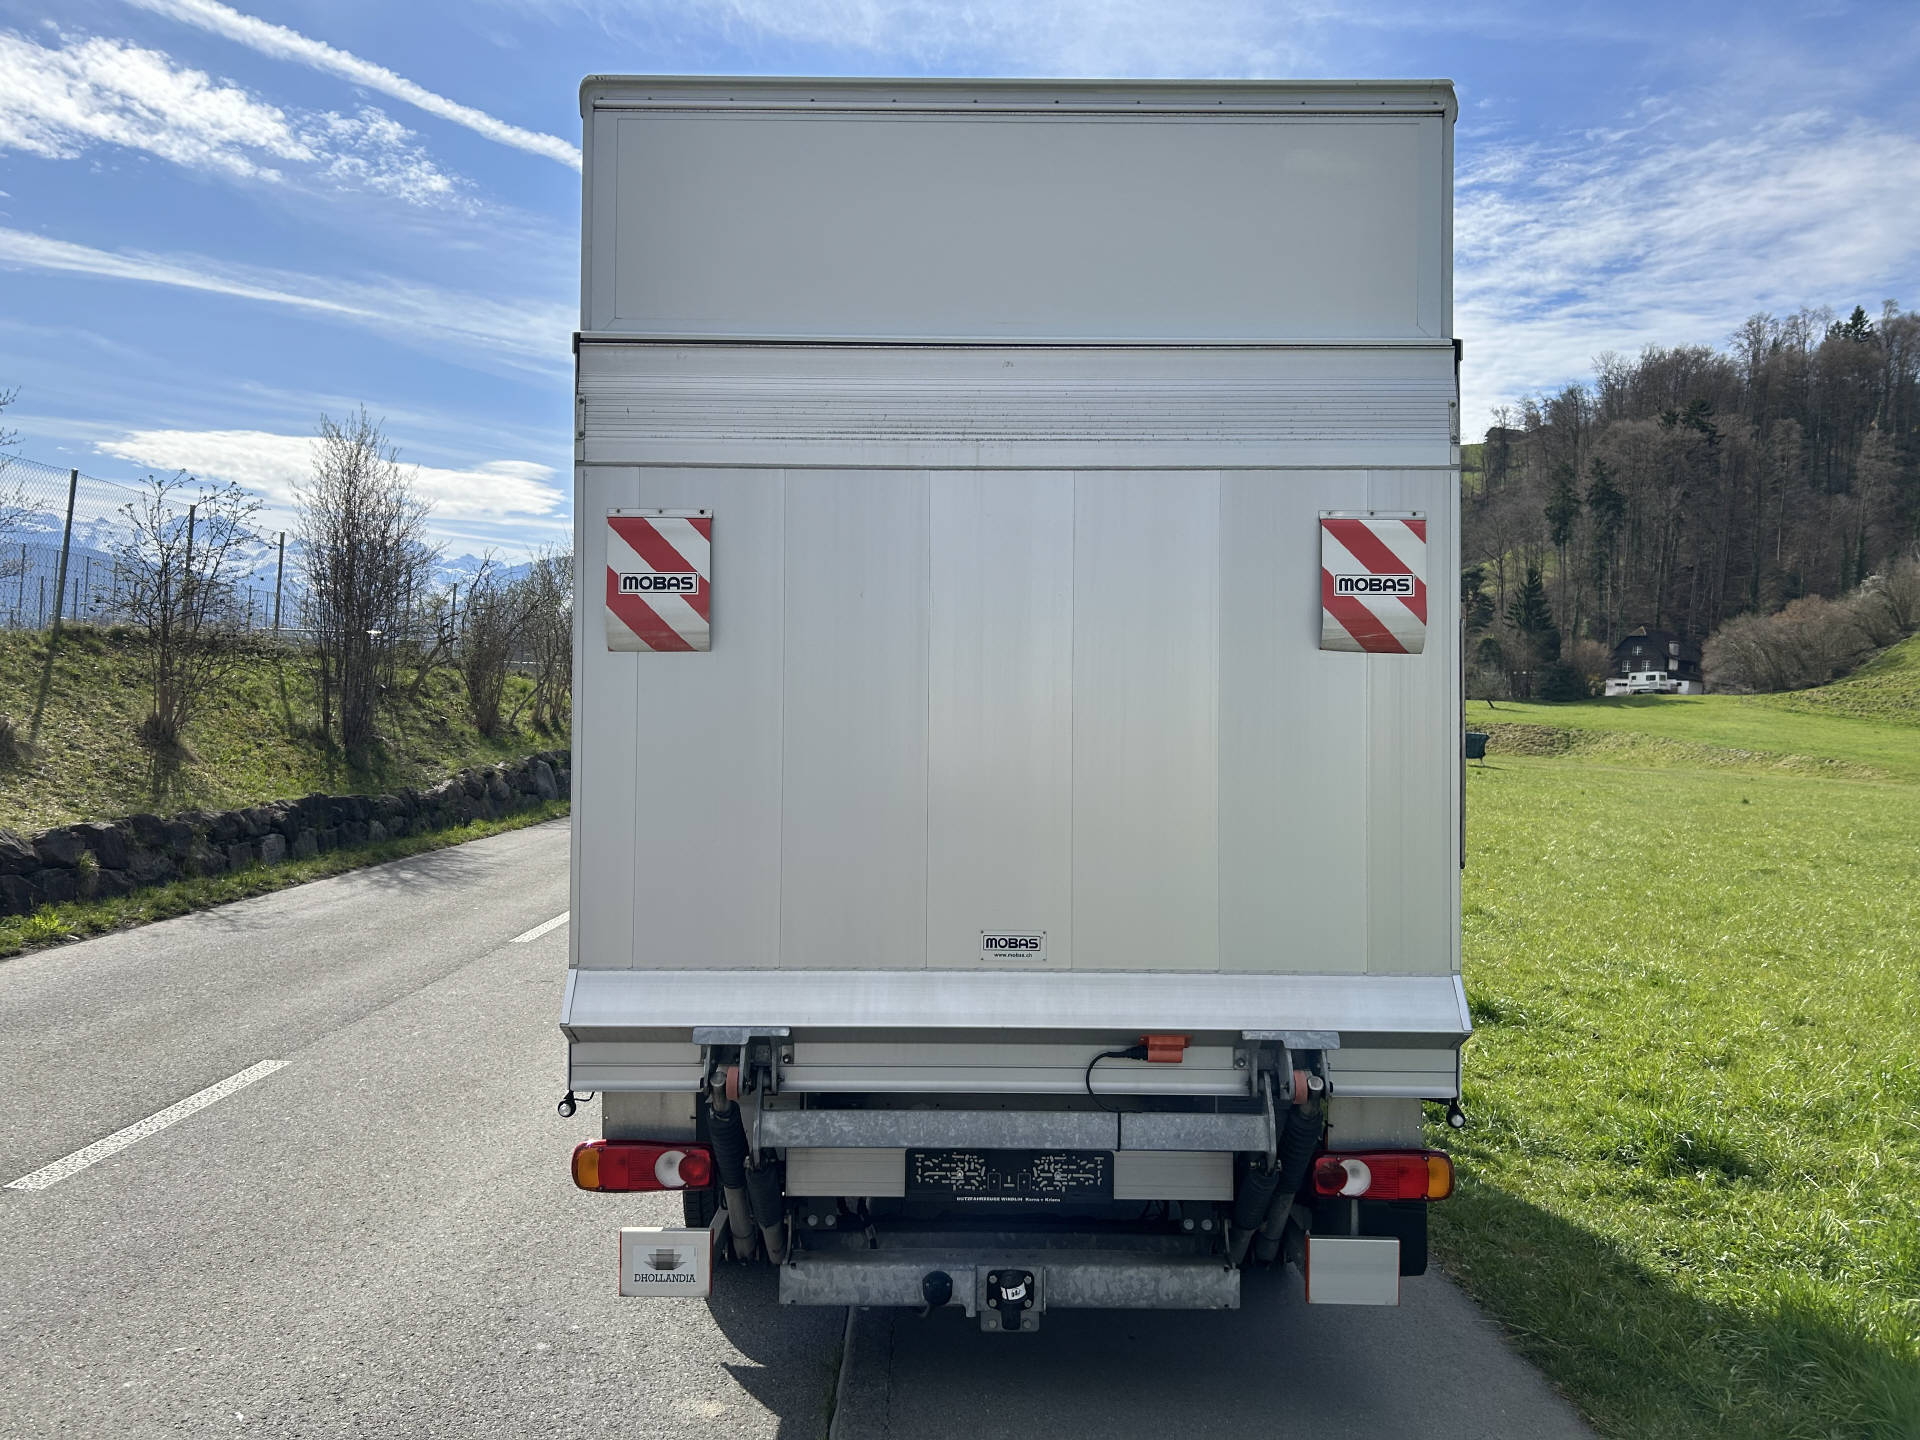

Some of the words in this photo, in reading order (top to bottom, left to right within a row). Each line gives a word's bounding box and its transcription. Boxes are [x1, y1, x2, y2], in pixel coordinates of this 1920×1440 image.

[622, 576, 694, 590] MOBAS
[1338, 577, 1410, 591] MOBAS
[985, 937, 1039, 949] MOBAS
[634, 1273, 696, 1283] DHOLLANDIA
